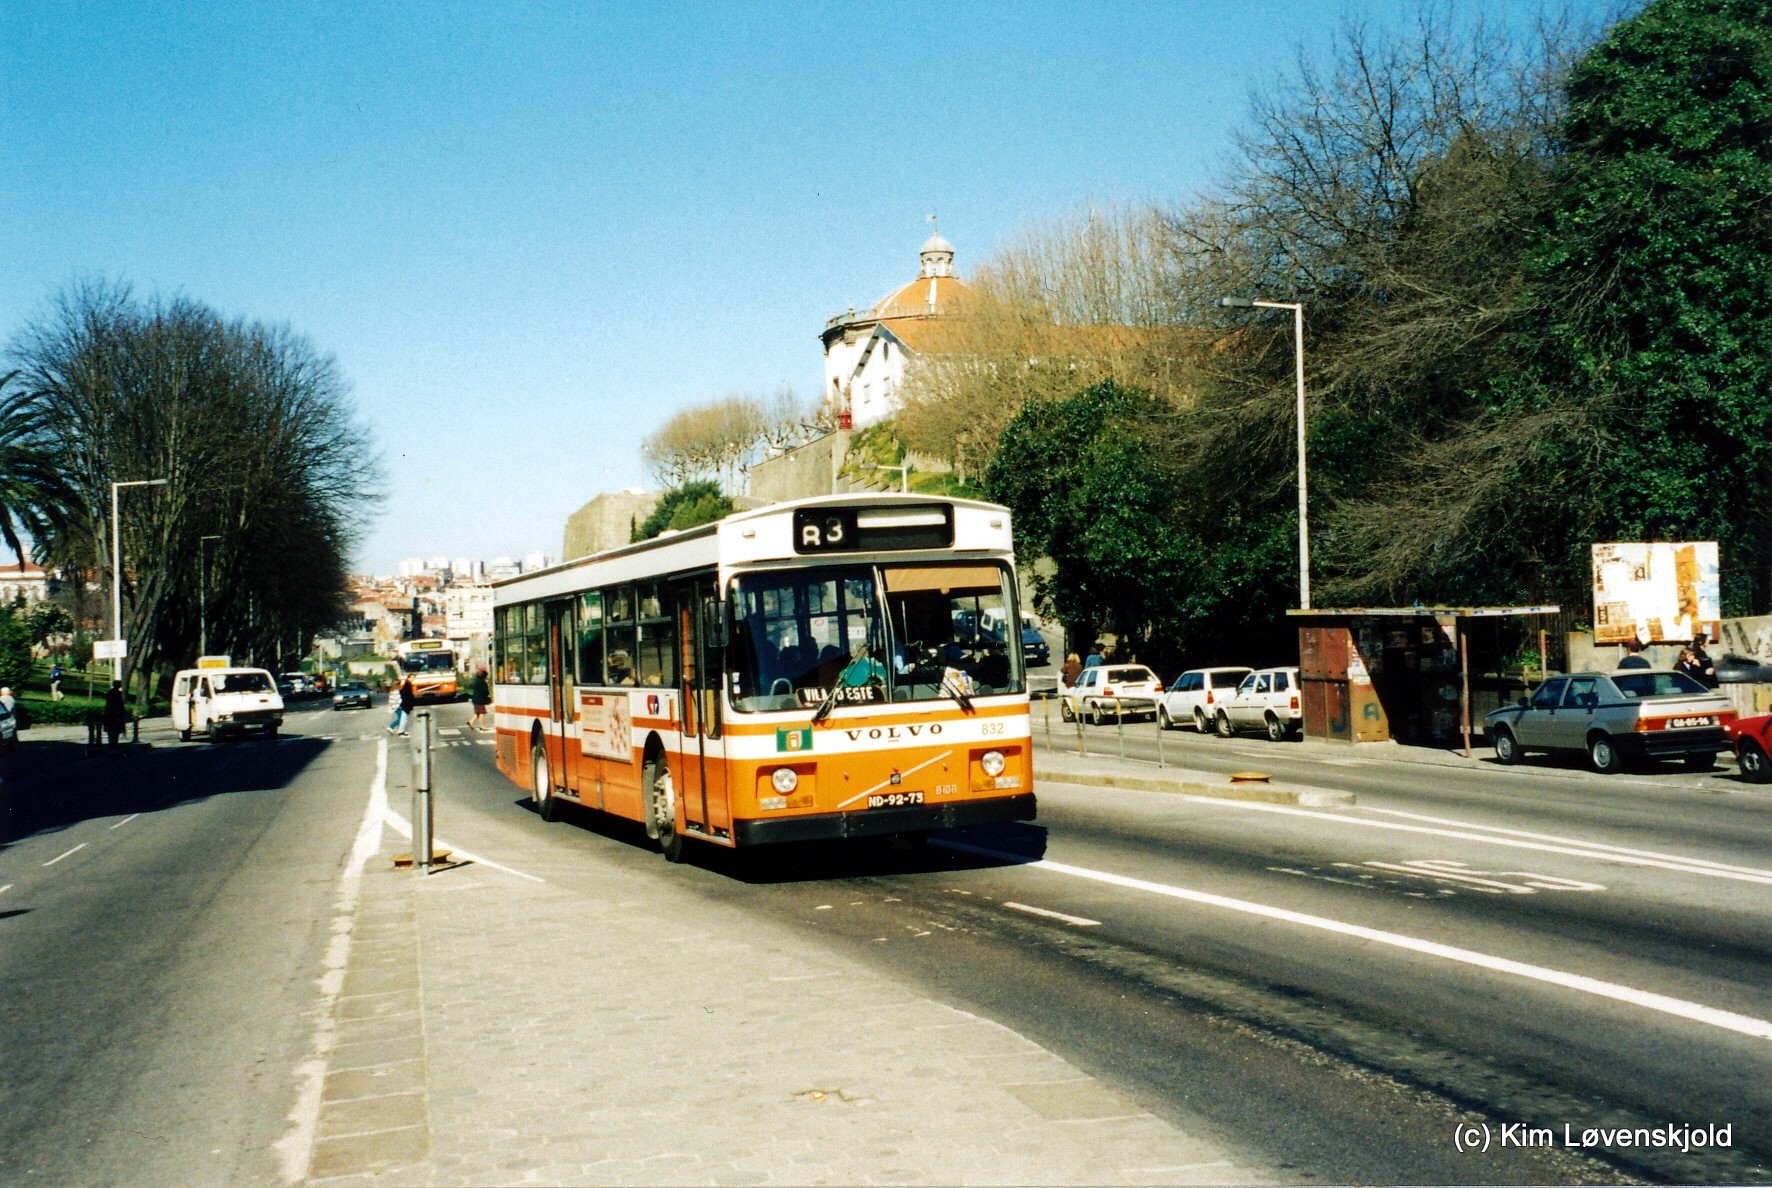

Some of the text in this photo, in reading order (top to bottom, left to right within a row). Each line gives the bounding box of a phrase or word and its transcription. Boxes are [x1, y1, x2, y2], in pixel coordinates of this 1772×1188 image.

[846, 724, 943, 741] VOLVO
[981, 723, 1004, 736] 832
[868, 792, 924, 808] ND-92-73
